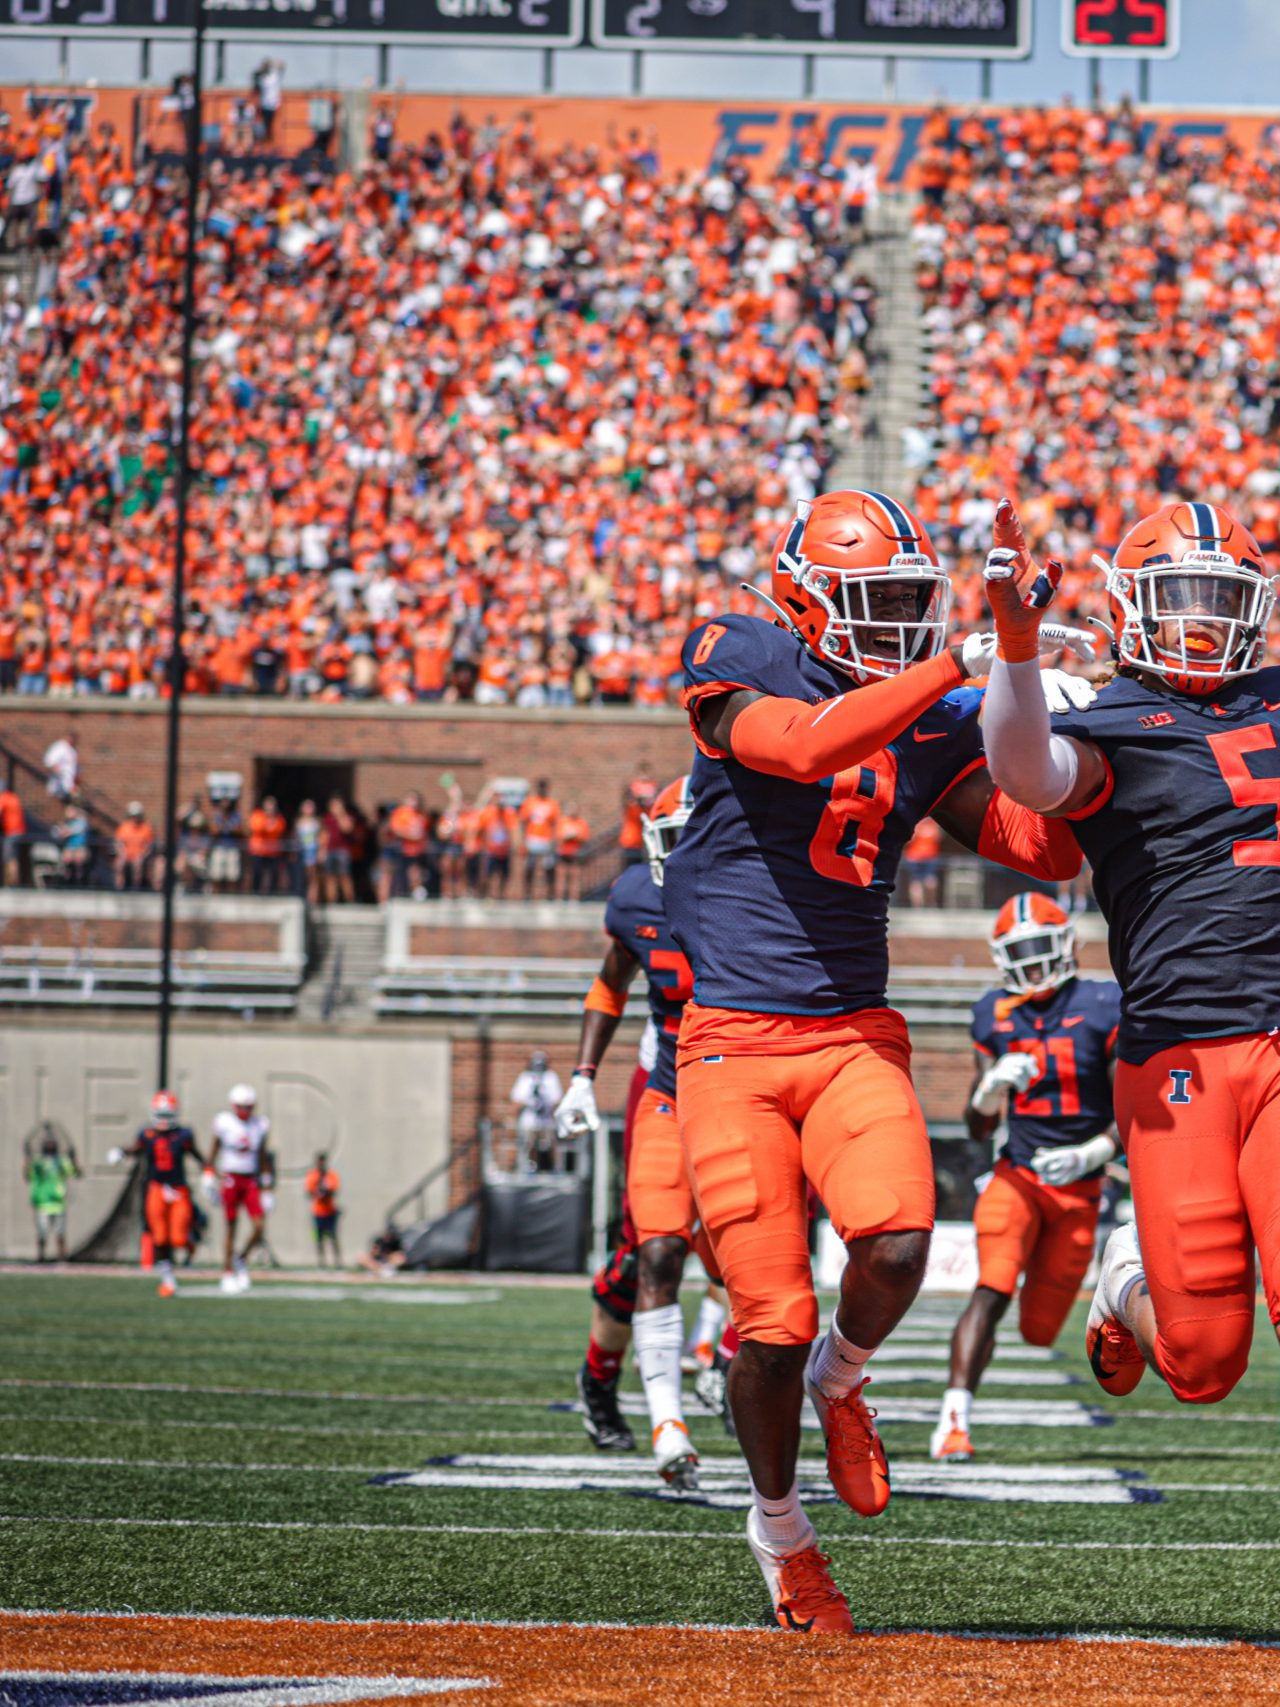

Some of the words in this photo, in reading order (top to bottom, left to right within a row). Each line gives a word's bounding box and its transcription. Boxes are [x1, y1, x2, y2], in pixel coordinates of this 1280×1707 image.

[1074, 0, 1167, 44] 25
[693, 624, 727, 665] 8
[808, 747, 898, 888] 8
[1007, 1036, 1081, 1116] 21
[1167, 1069, 1192, 1105] I
